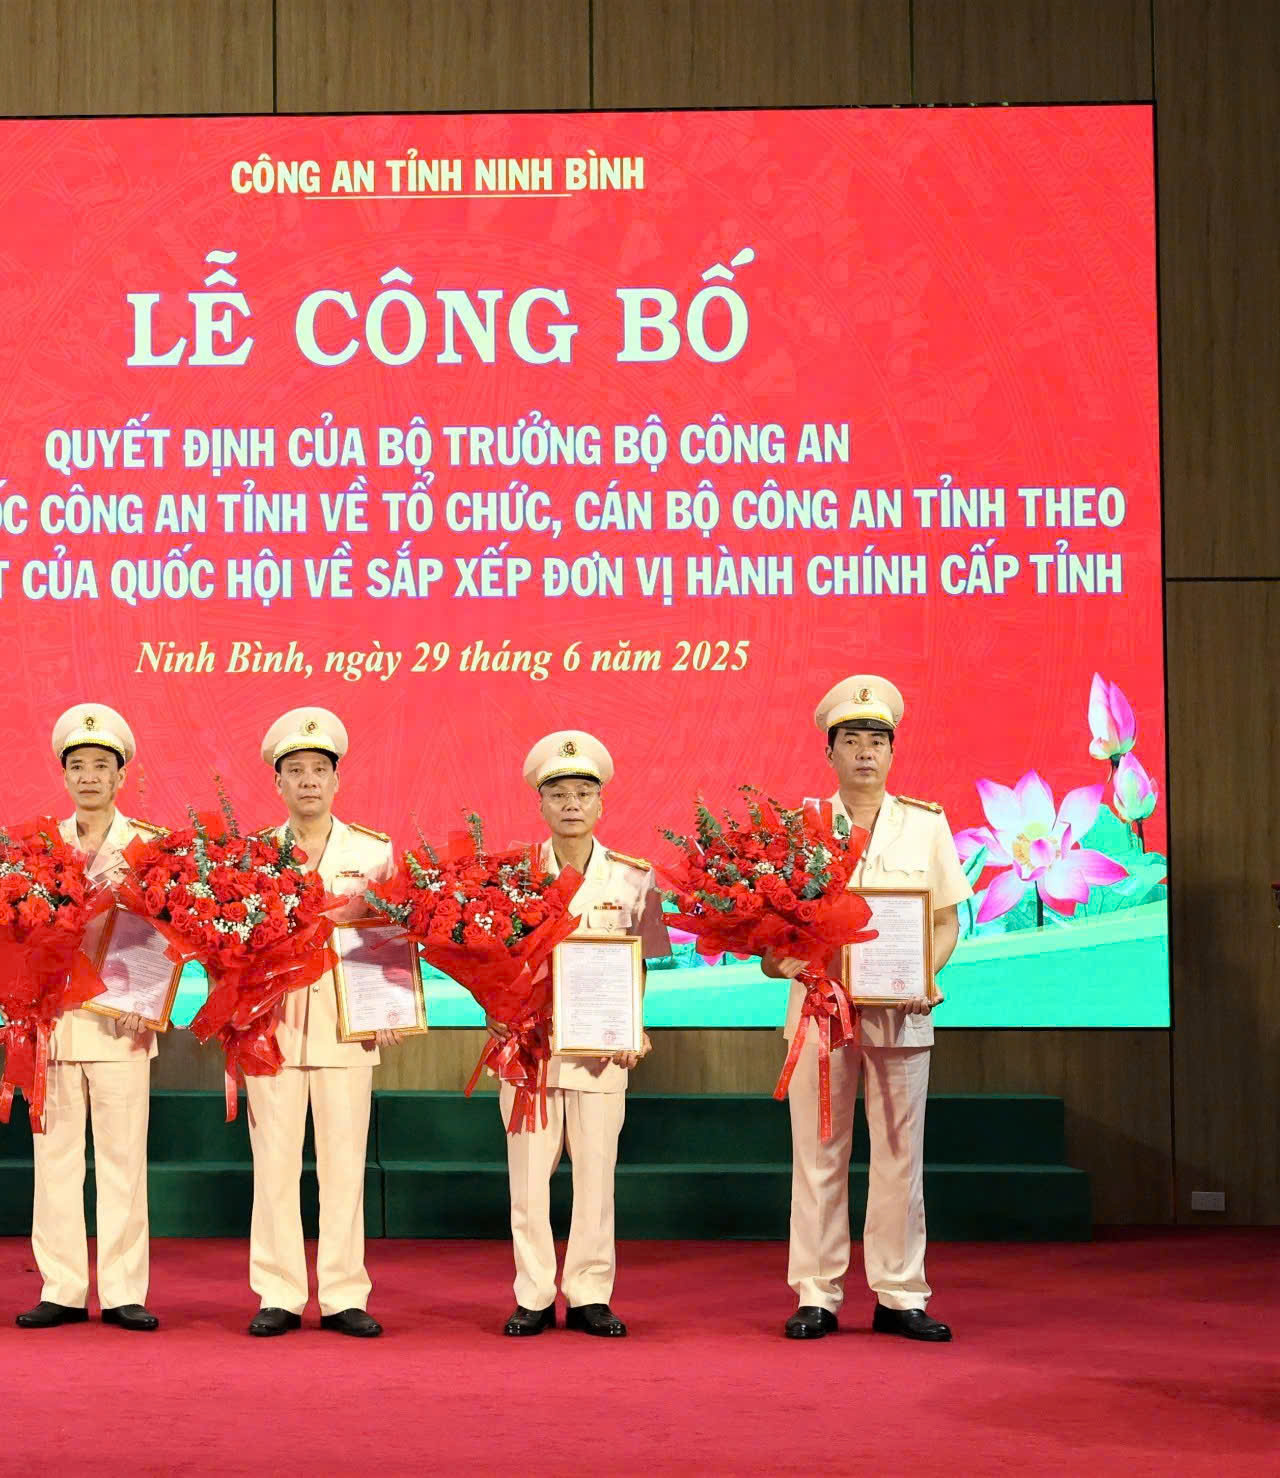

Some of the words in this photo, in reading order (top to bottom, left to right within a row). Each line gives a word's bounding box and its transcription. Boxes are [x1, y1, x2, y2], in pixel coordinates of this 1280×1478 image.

[231, 152, 321, 194] CÔNG
[330, 159, 375, 193] AN
[385, 147, 462, 193] TỈNH
[474, 157, 553, 192] NINH
[565, 149, 645, 191] BÌNH
[126, 249, 254, 367] LỄ
[295, 266, 579, 367] CÔNG
[615, 247, 755, 363] BỐ
[44, 413, 171, 476] QUYẾT
[182, 428, 275, 477] ĐỊNH
[287, 411, 367, 468] CỦA
[378, 415, 433, 475] BỘ
[442, 410, 601, 466] TRƯỞNG
[614, 413, 668, 473] BỘ
[679, 413, 786, 465] CÔNG
[796, 423, 849, 463] AN
[39, 483, 144, 535] CÔNG
[154, 493, 206, 533] AN
[216, 478, 307, 533] TỈNH
[319, 475, 369, 532] VỀ
[381, 470, 435, 533] TỔ
[445, 480, 562, 539] CHỨC,
[574, 479, 652, 531] CÁN
[666, 479, 720, 539] BỘ
[732, 479, 838, 530] CÔNG
[849, 488, 902, 529] AN
[913, 473, 1005, 528] TỈNH
[1017, 486, 1126, 528] THEO
[21, 544, 99, 600] CỦA
[110, 543, 215, 607] QUỐC
[227, 547, 292, 607] HỘI
[303, 540, 353, 598] VỀ
[366, 540, 444, 598] SẮP
[454, 541, 532, 597] XẾP
[541, 550, 624, 598] ĐƠN
[635, 556, 673, 606] VỊ
[686, 545, 793, 596] HÀNH
[806, 544, 927, 596] CHÍNH
[940, 540, 1020, 595] CẤP
[1029, 539, 1122, 594] TỈNH
[134, 640, 216, 673] Ninh
[224, 640, 313, 679] Bình,
[324, 640, 403, 682] ngày
[410, 641, 450, 673] 29
[459, 639, 553, 681] tháng
[563, 641, 582, 672] 6
[590, 639, 662, 672] năm
[671, 639, 750, 672] 2025
